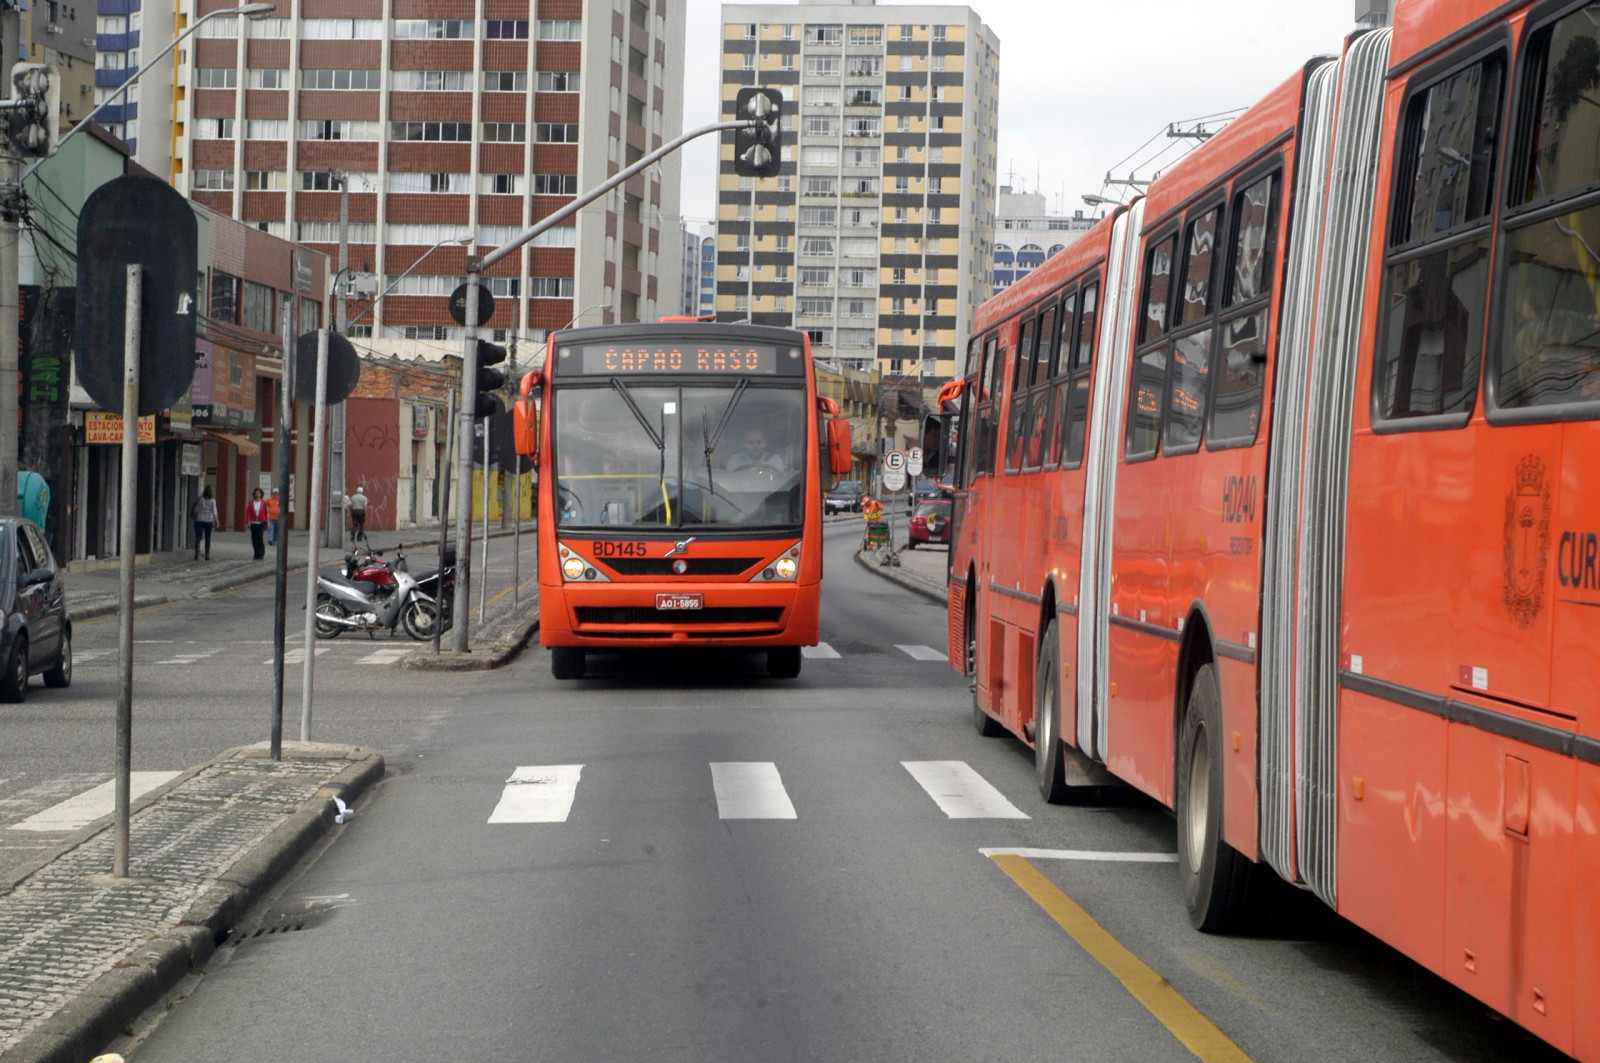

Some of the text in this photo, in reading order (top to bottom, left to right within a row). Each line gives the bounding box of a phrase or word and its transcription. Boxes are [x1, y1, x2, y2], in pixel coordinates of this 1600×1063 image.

[698, 348, 759, 371] RASO
[890, 454, 900, 467] E
[911, 450, 919, 459] E
[1222, 475, 1257, 524] HD240
[593, 541, 647, 556] BD145
